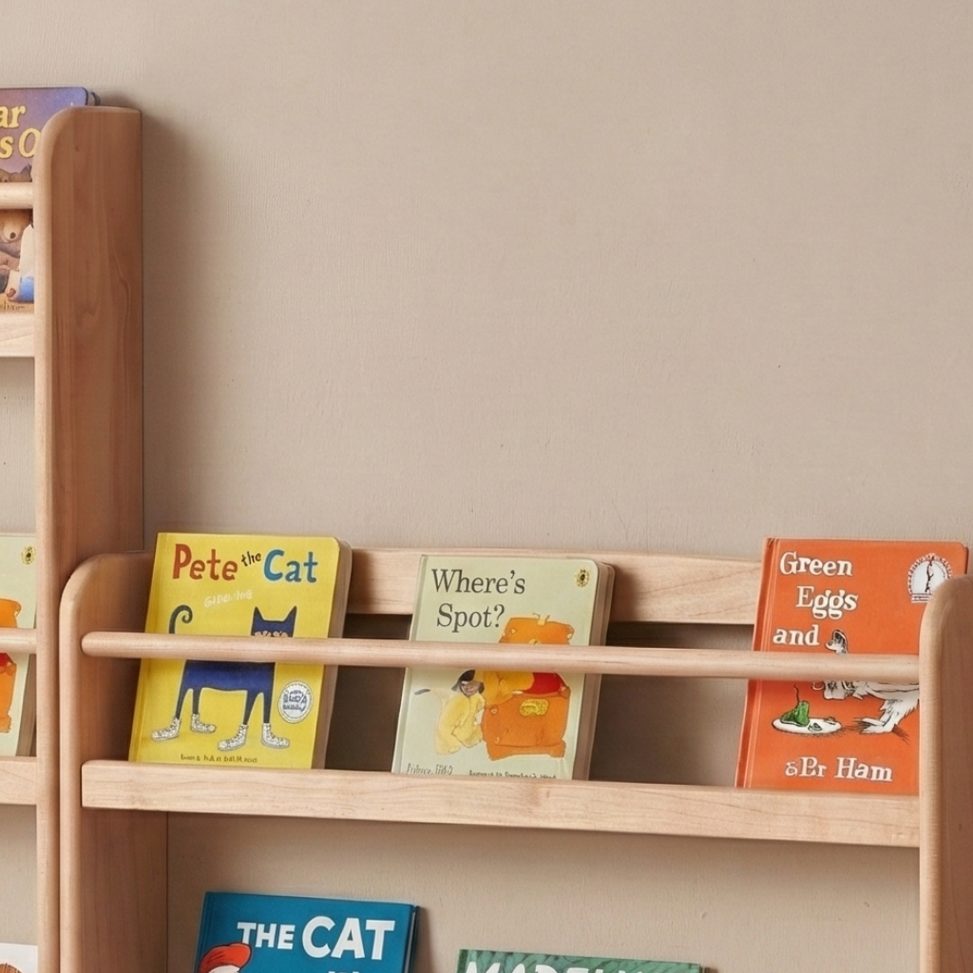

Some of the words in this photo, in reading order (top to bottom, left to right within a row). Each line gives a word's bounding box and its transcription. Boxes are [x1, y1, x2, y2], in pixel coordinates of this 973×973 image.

[19, 128, 41, 158] O
[172, 544, 238, 581] Pete
[241, 551, 261, 566] the
[263, 549, 319, 583] Cat
[779, 551, 853, 576] Green
[431, 569, 525, 594] Where's
[436, 602, 505, 633] Spot?
[795, 586, 859, 620] Eggs
[772, 624, 820, 646] and
[834, 756, 893, 782] Ham
[237, 922, 295, 950] THE
[302, 916, 395, 960] CAT
